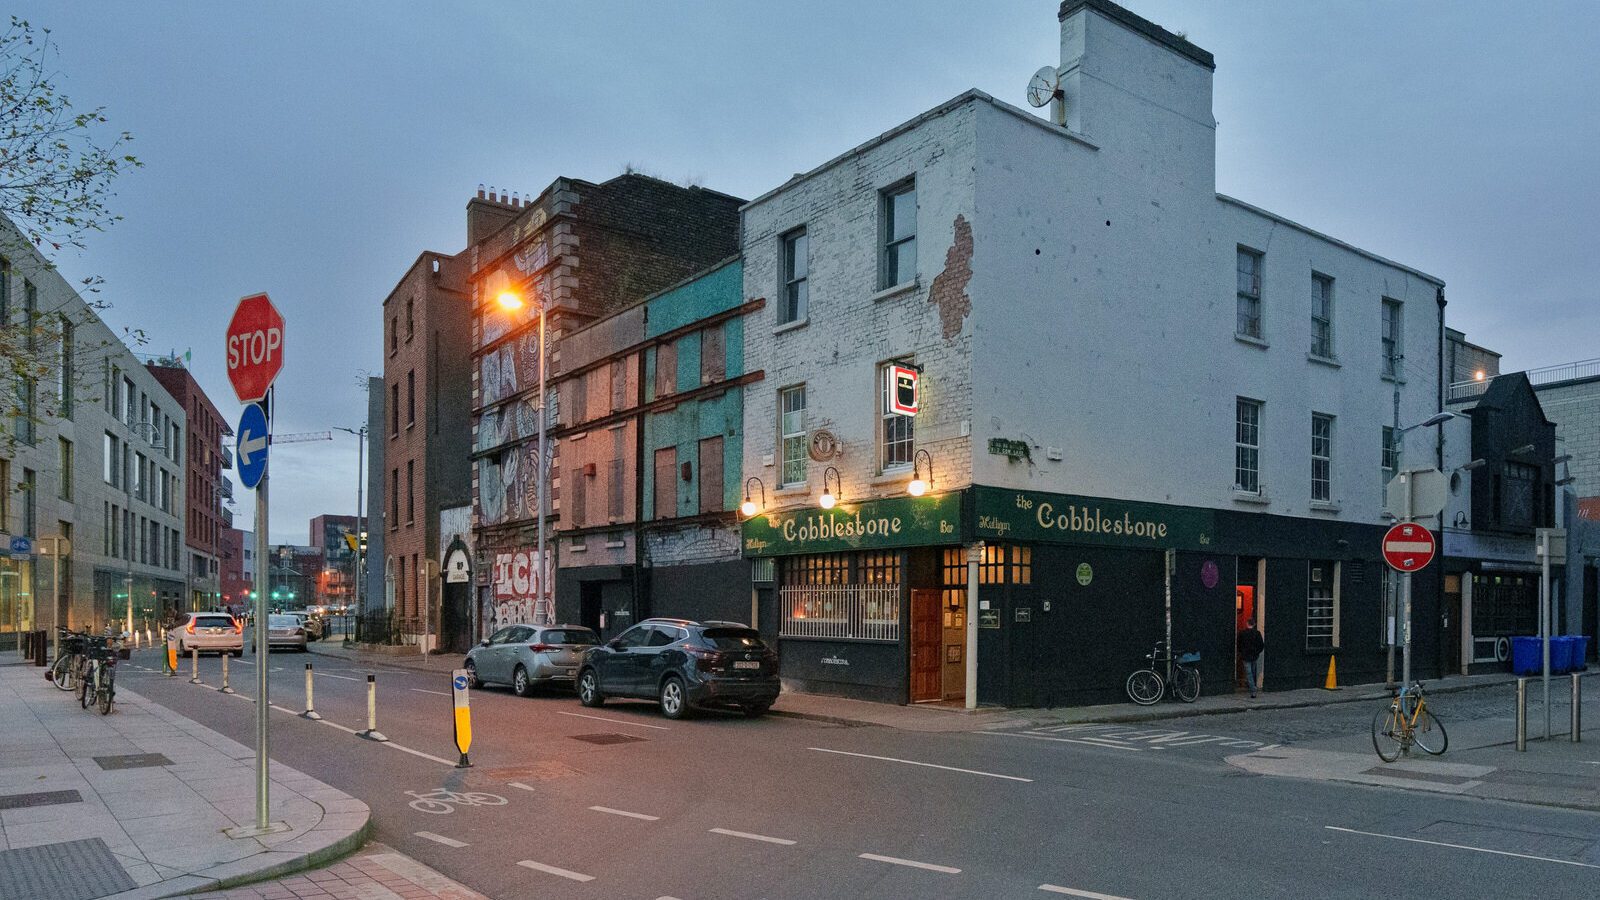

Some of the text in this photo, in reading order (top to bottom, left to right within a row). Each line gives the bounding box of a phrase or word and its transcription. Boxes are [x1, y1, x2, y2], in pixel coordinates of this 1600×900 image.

[229, 328, 281, 369] STOP
[1016, 494, 1033, 510] the
[783, 511, 902, 541] Cobblestone
[940, 520, 954, 534] Bar
[1037, 503, 1167, 539] Cobblestone
